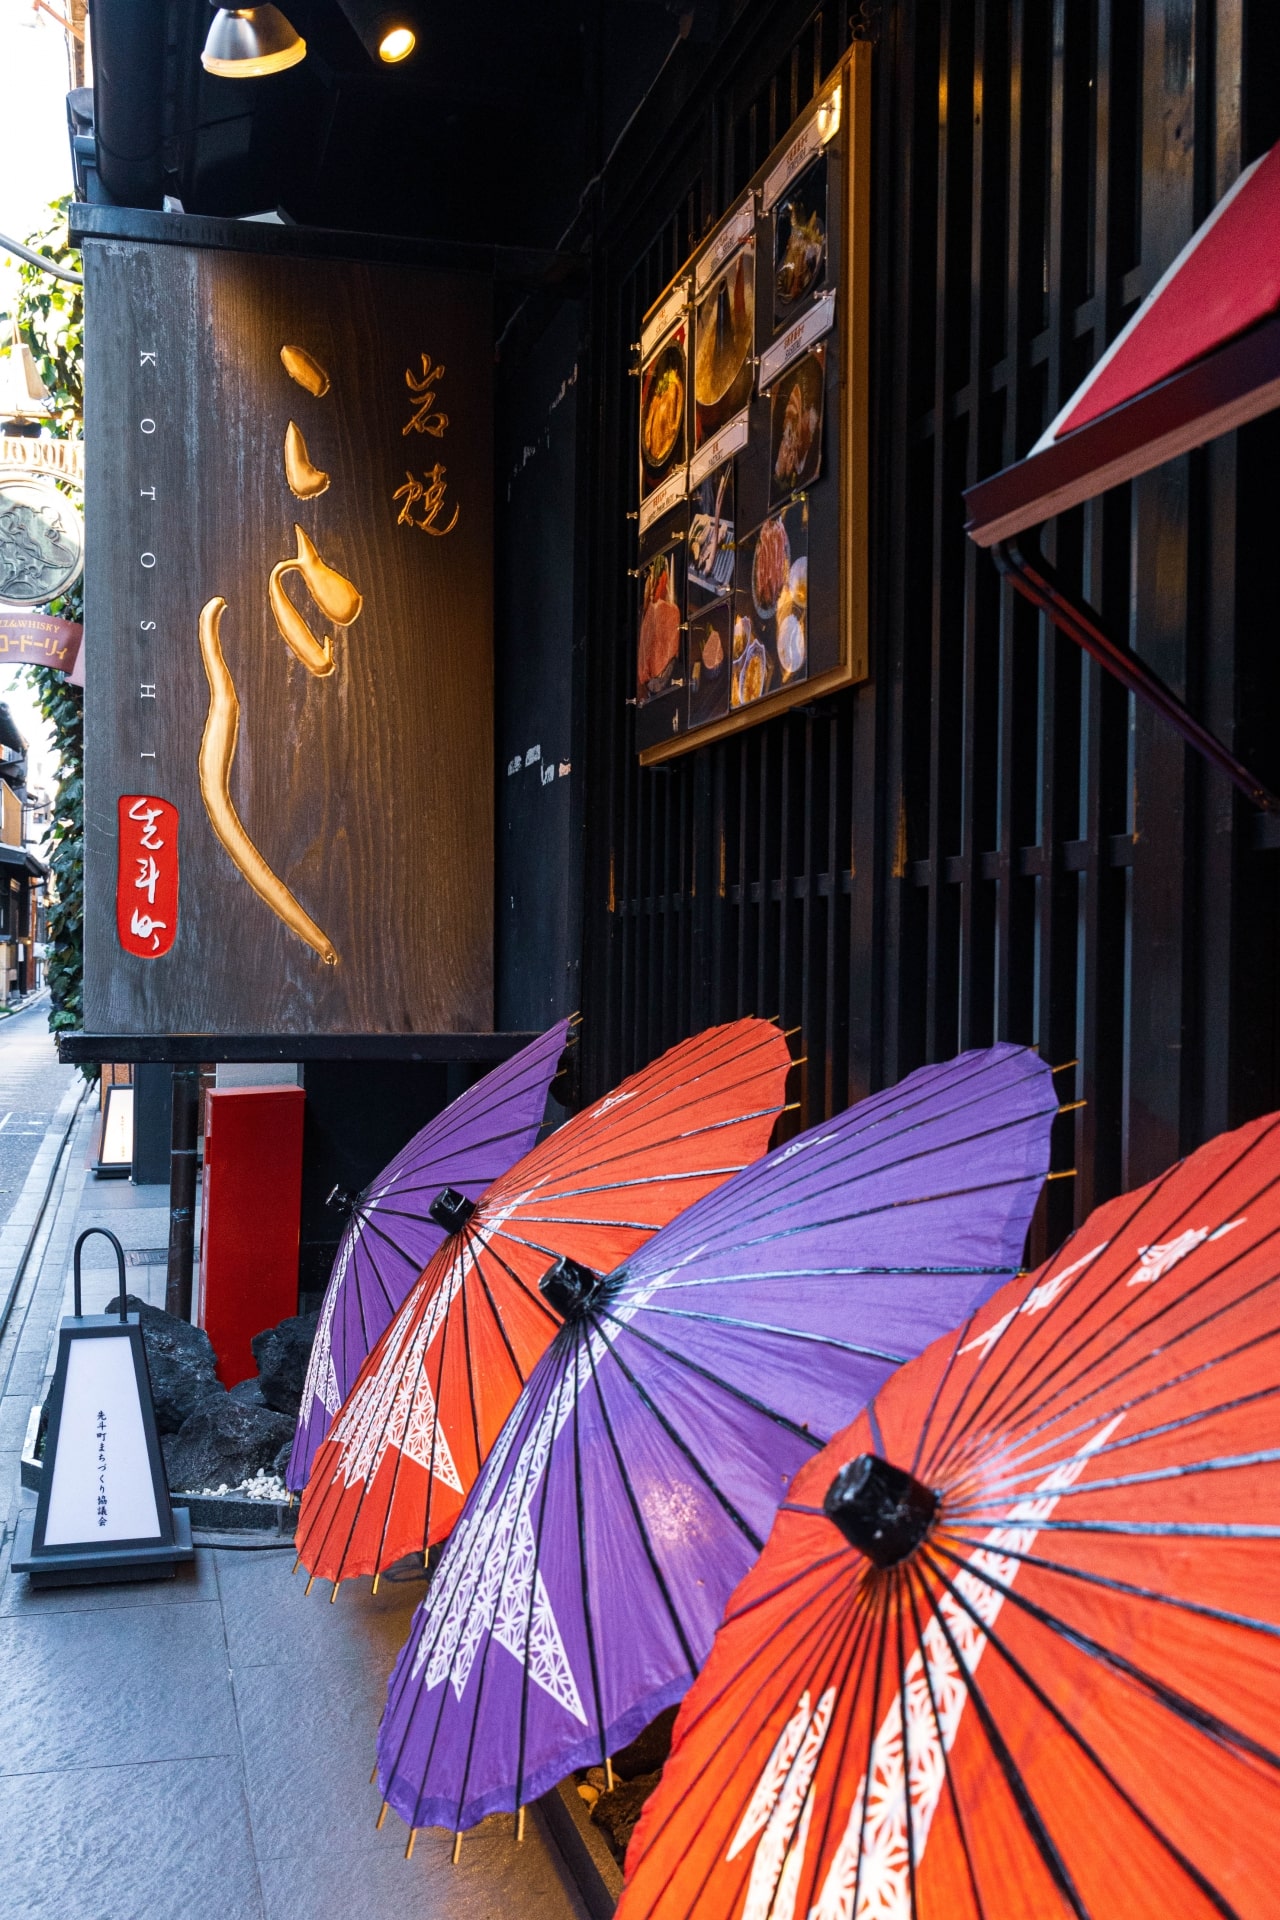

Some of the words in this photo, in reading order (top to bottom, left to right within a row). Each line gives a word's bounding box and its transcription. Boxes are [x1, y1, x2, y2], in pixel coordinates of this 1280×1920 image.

[140, 350, 156, 759] KOTOSHI
[97, 1410, 107, 1527] 先斗町まちづくり協議会
